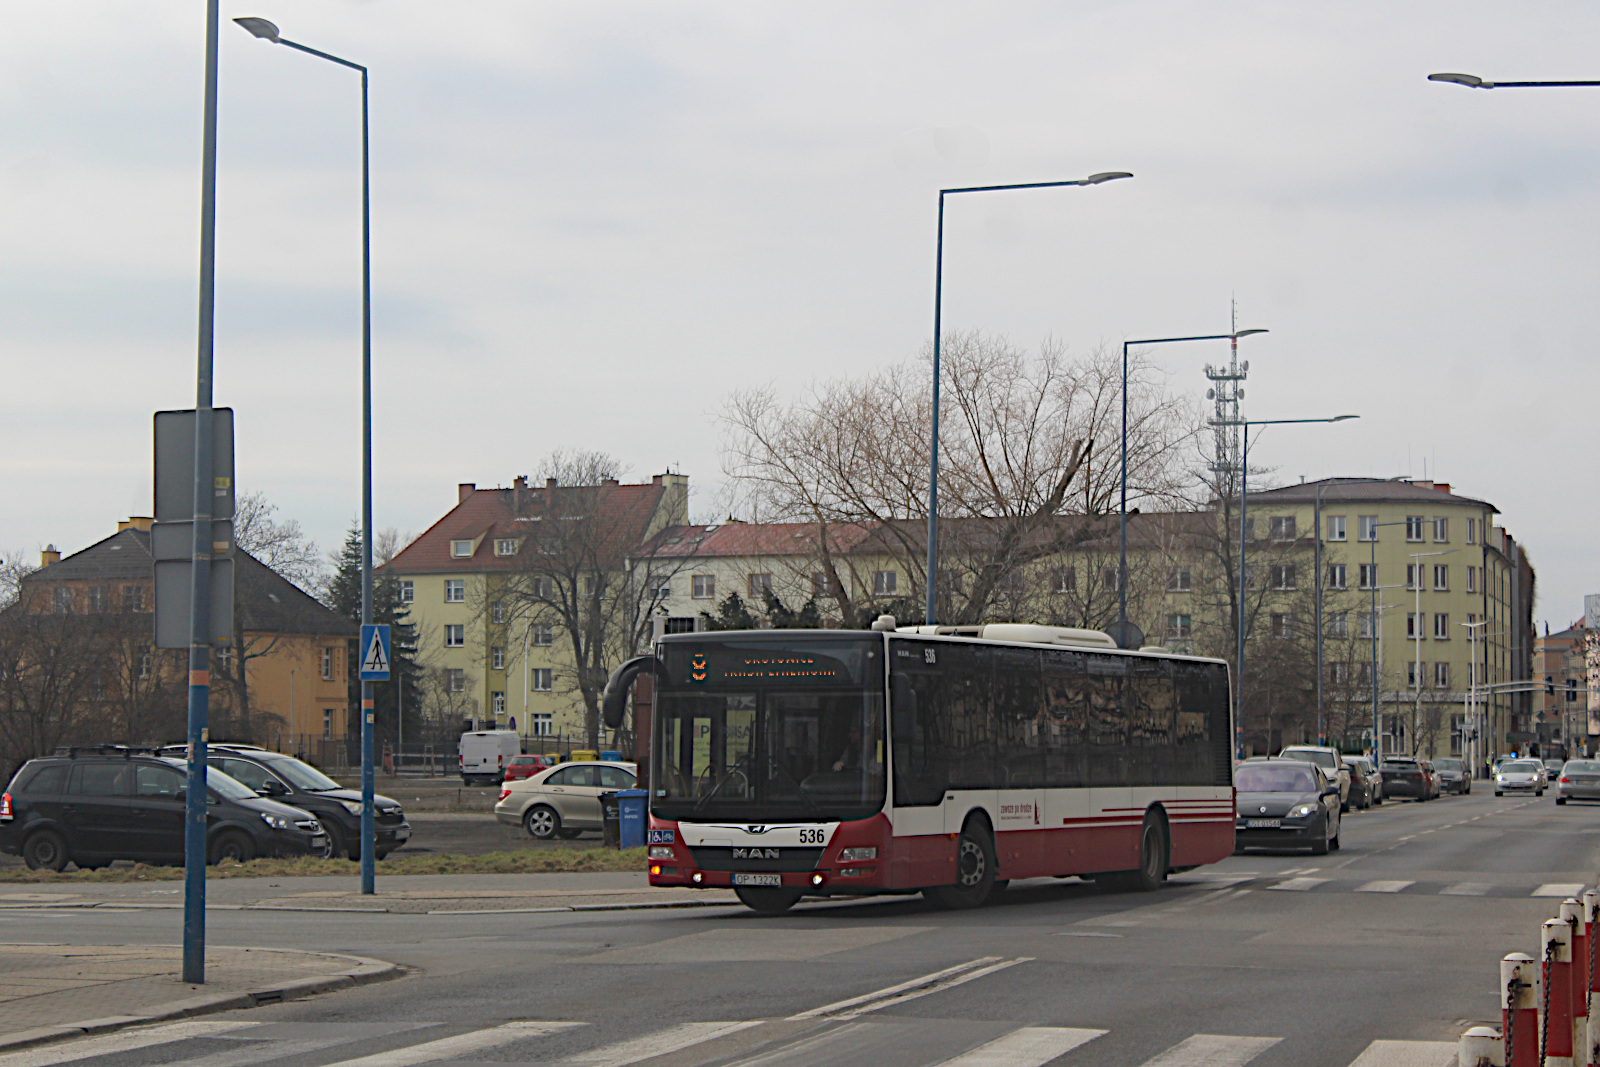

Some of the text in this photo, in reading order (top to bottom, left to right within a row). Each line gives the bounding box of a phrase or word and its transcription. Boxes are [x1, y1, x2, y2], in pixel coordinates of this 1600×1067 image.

[925, 649, 936, 663] 536
[799, 829, 825, 844] 536
[733, 848, 780, 858] MAN
[736, 874, 779, 885] OP 1322K
